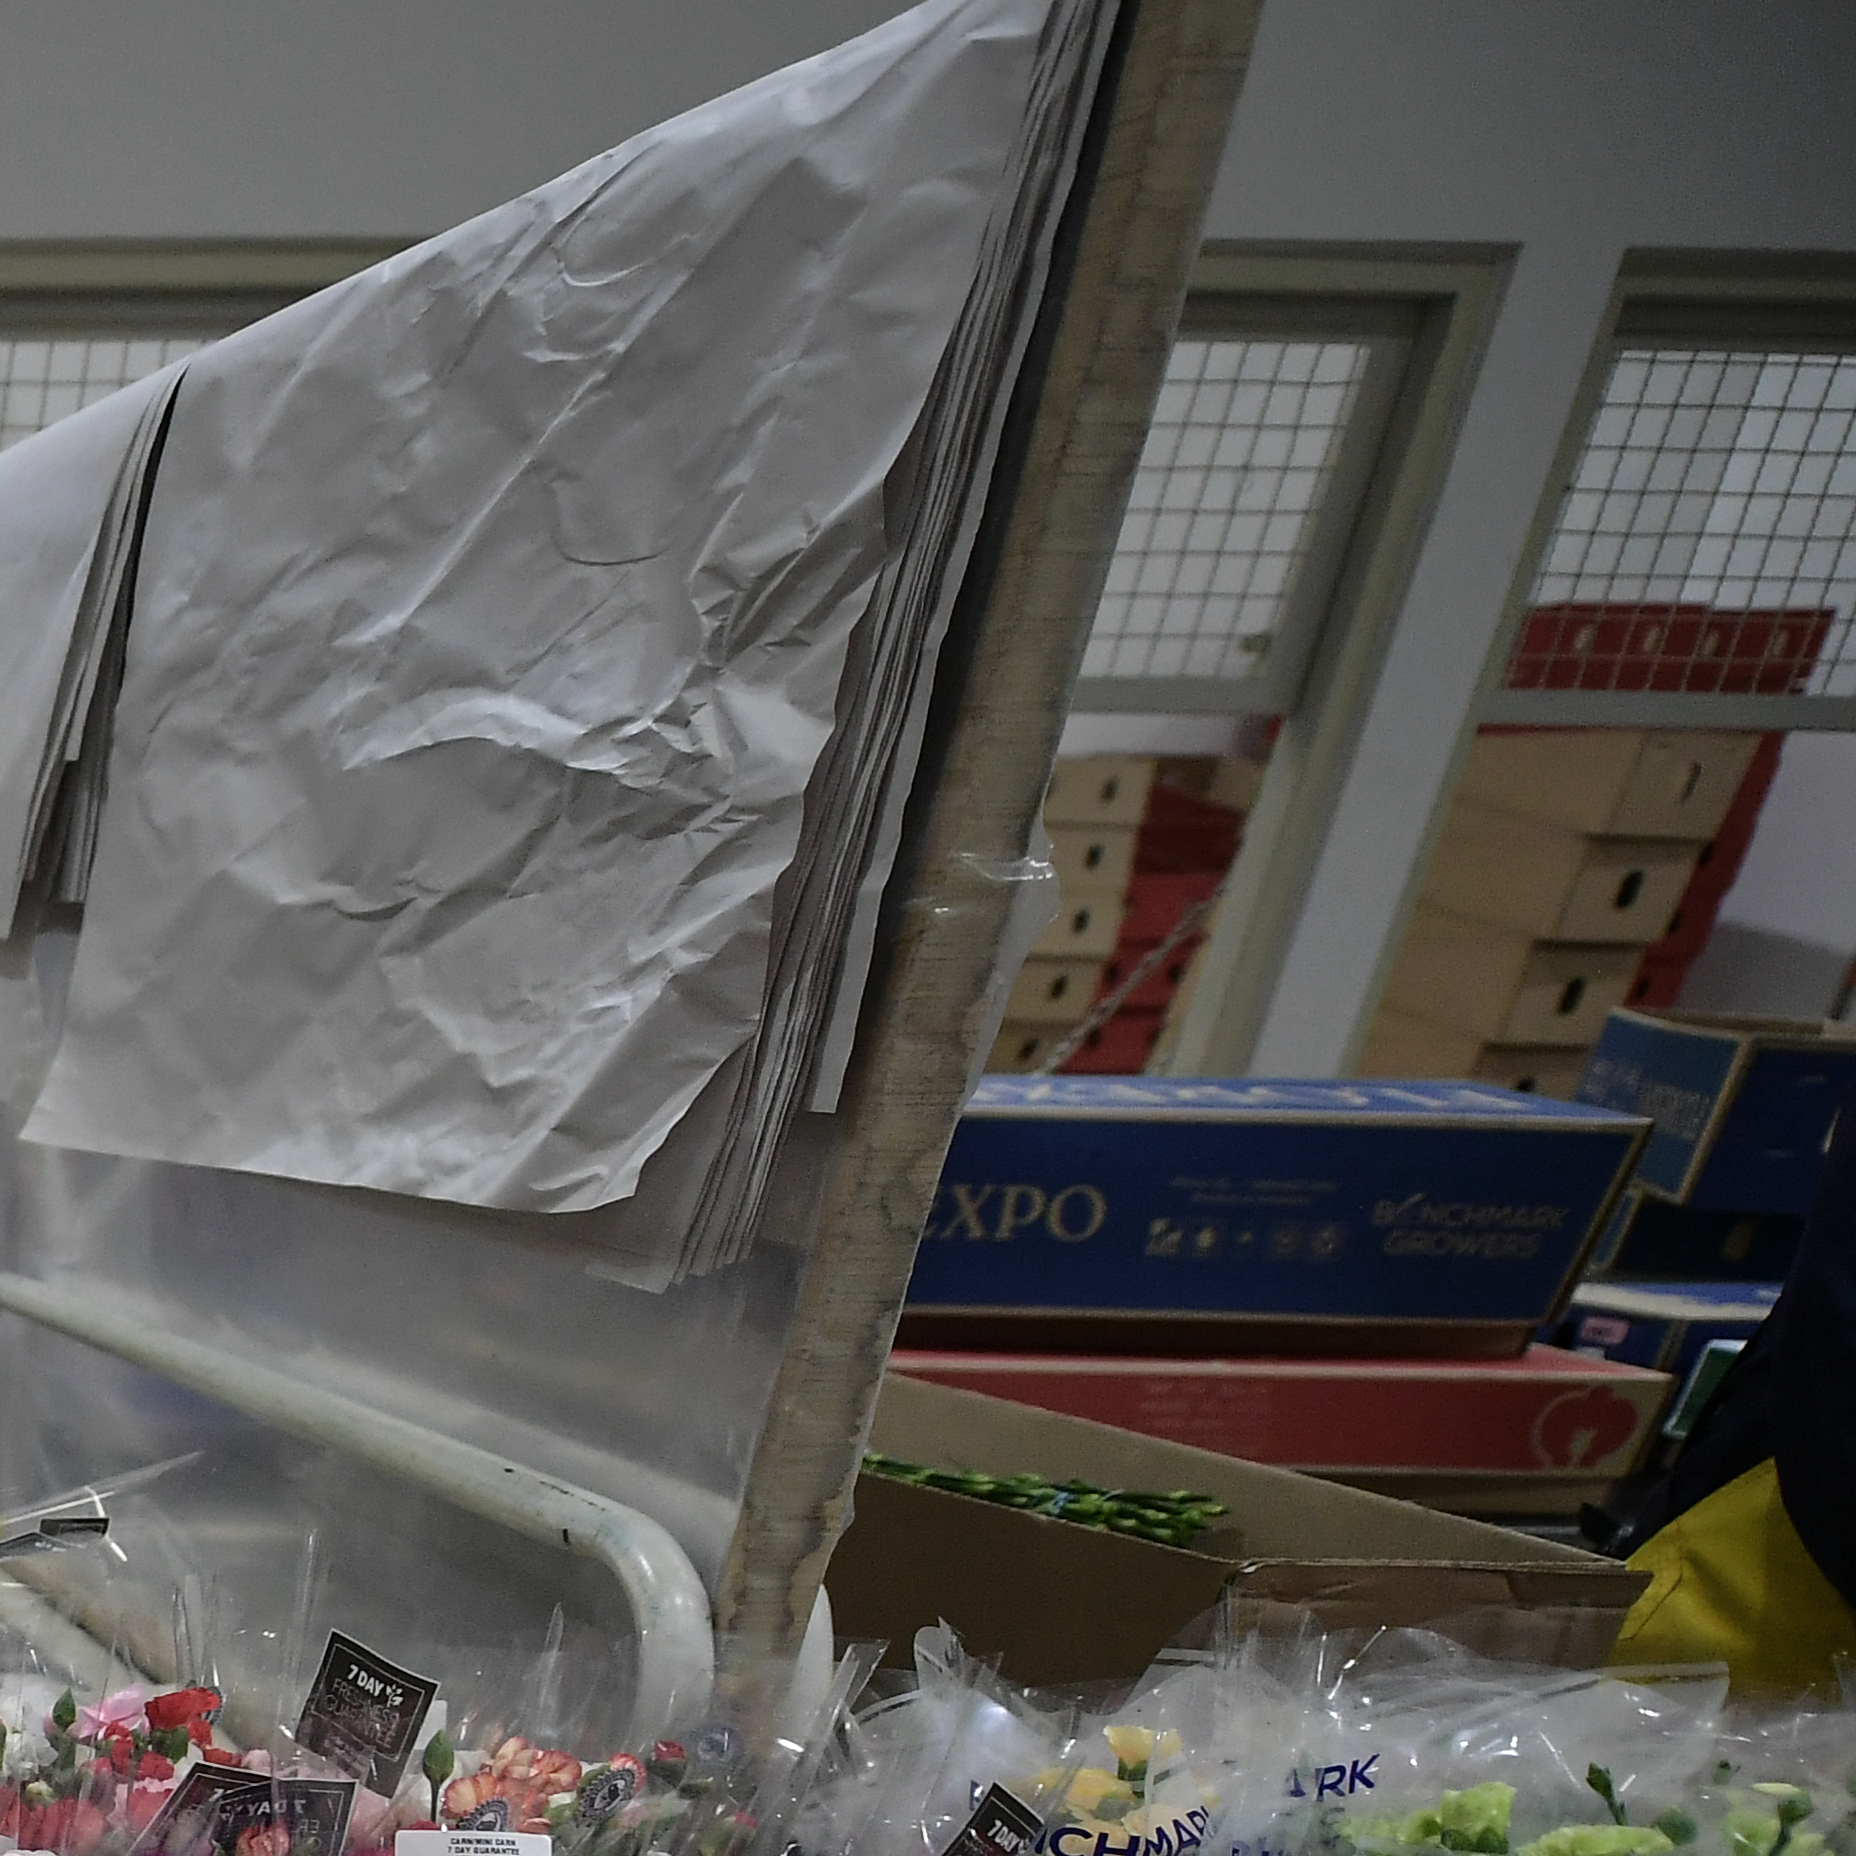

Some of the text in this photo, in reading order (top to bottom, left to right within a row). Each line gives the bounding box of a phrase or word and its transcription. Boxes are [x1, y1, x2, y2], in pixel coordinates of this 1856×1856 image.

[347, 1664, 385, 1697] 7 DAY
[987, 1818, 1002, 1837] 7
[454, 1846, 470, 1854] DAY
[473, 1847, 519, 1855] GUARANTEE
